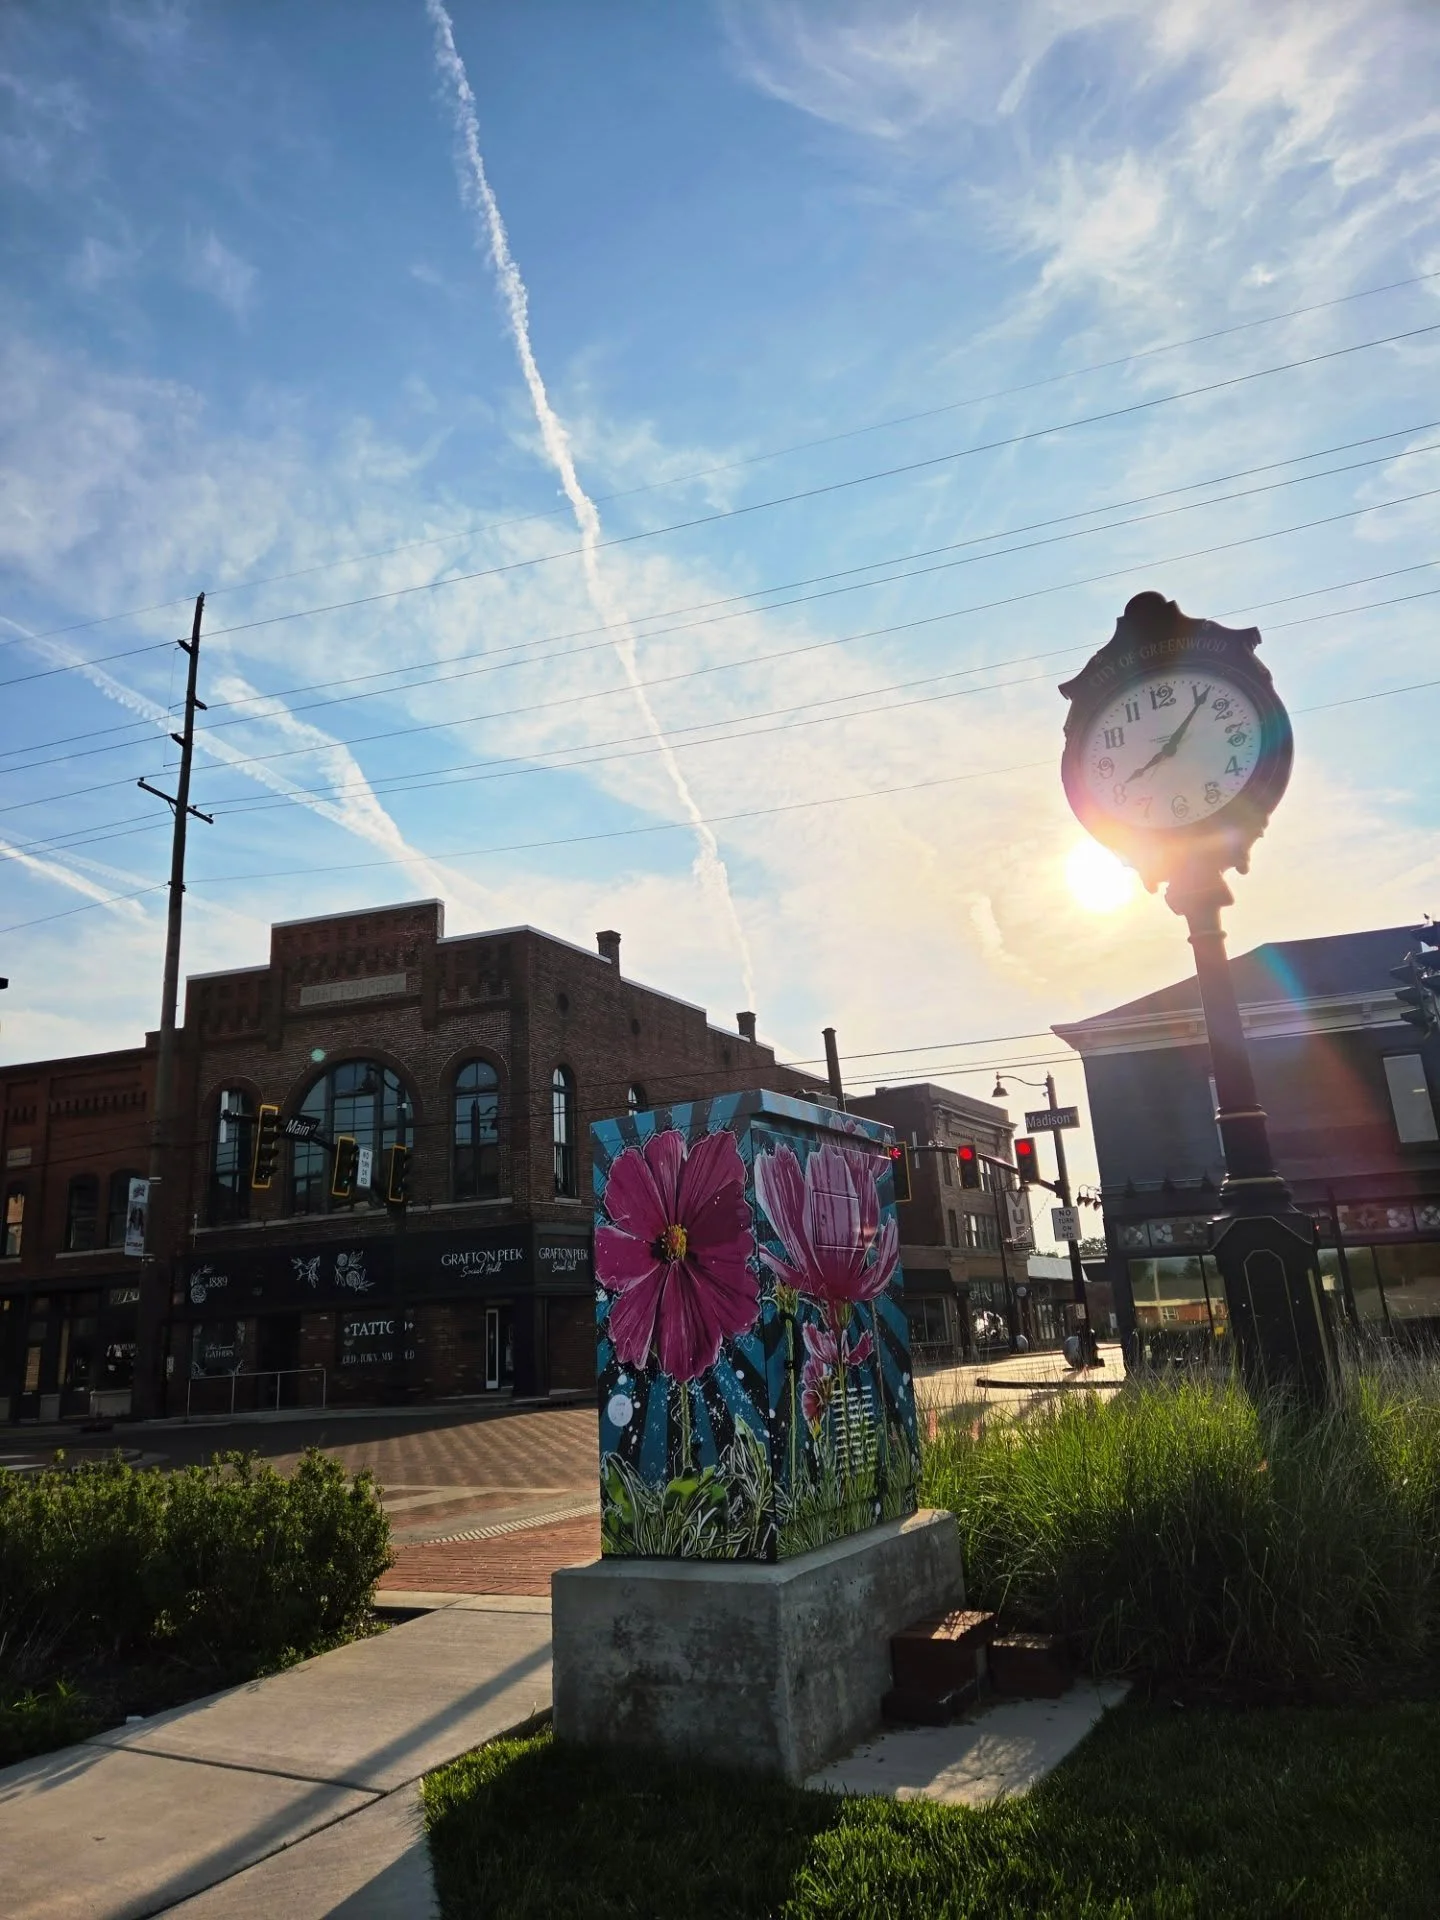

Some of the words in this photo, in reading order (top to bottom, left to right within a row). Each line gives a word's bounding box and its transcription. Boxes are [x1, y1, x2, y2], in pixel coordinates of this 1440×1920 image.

[1089, 664, 1115, 688] CITY
[1119, 652, 1135, 668] OF
[1139, 637, 1227, 659] GREENWOOD
[1150, 685, 1177, 710] 12
[1125, 702, 1141, 723] 11
[1211, 698, 1233, 721] 2
[1103, 727, 1125, 749] 10
[1225, 721, 1247, 747] 3
[1097, 757, 1115, 779] 9
[1224, 755, 1244, 776] 4
[1113, 783, 1127, 805] 8
[1204, 781, 1221, 804] 5
[1137, 796, 1153, 818] 7
[1171, 795, 1190, 818] 6
[285, 1119, 310, 1136] Main
[1025, 1114, 1070, 1128] Madison
[1059, 1209, 1071, 1217] NO
[441, 1250, 496, 1266] GRAFTON
[497, 1248, 523, 1262] PEEK
[538, 1247, 572, 1260] GRAFTON
[573, 1248, 589, 1261] PEEK
[485, 1261, 502, 1275] Hall
[350, 1320, 408, 1336] TATTO
